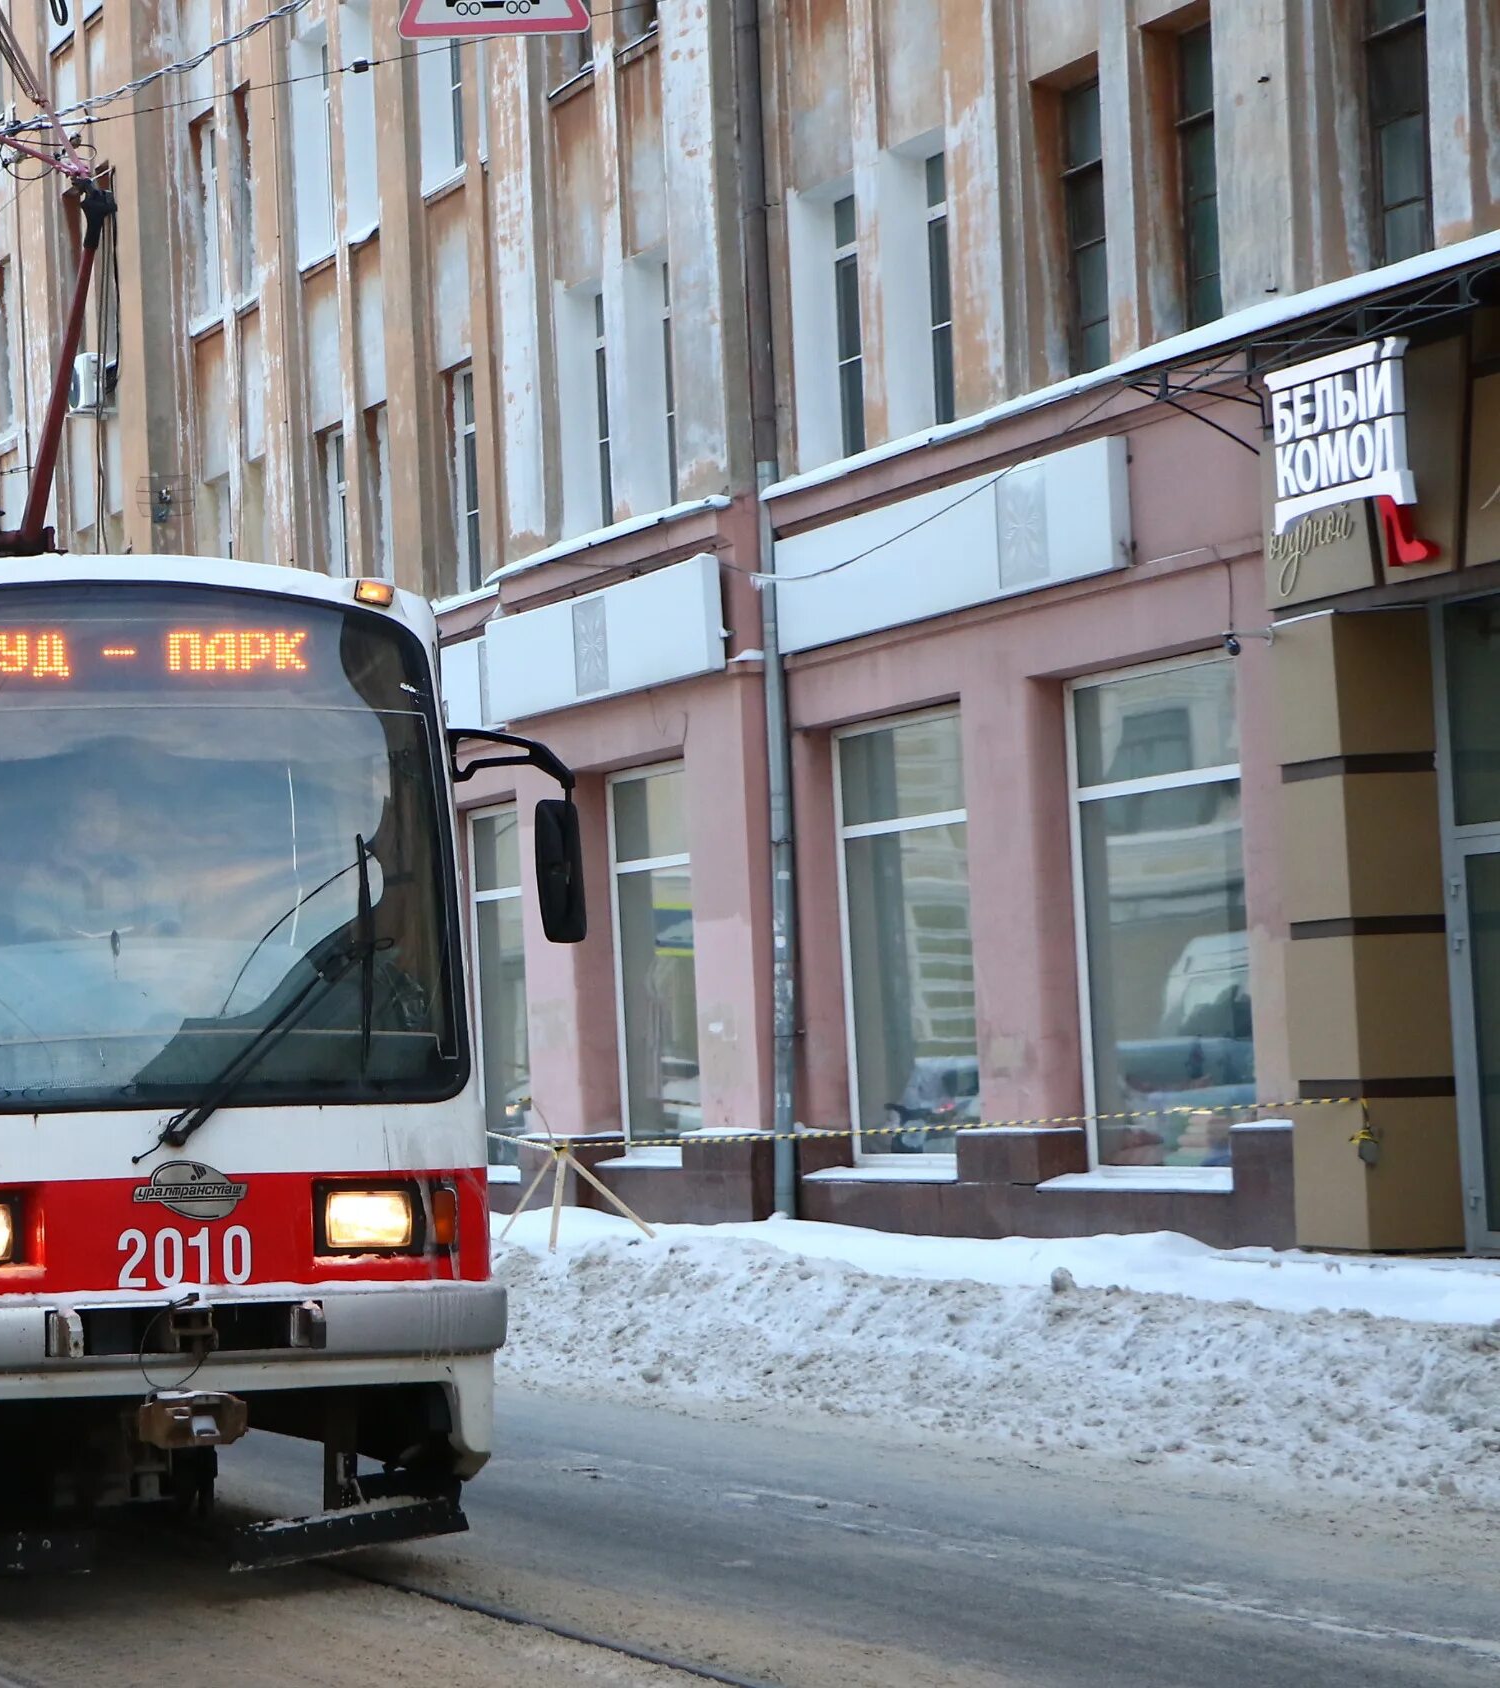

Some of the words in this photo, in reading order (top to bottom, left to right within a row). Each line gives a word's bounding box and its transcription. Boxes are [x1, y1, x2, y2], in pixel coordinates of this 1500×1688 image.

[1275, 415, 1396, 498] КОМОД
[168, 631, 307, 672] ПАРК
[117, 1224, 252, 1288] 2010
